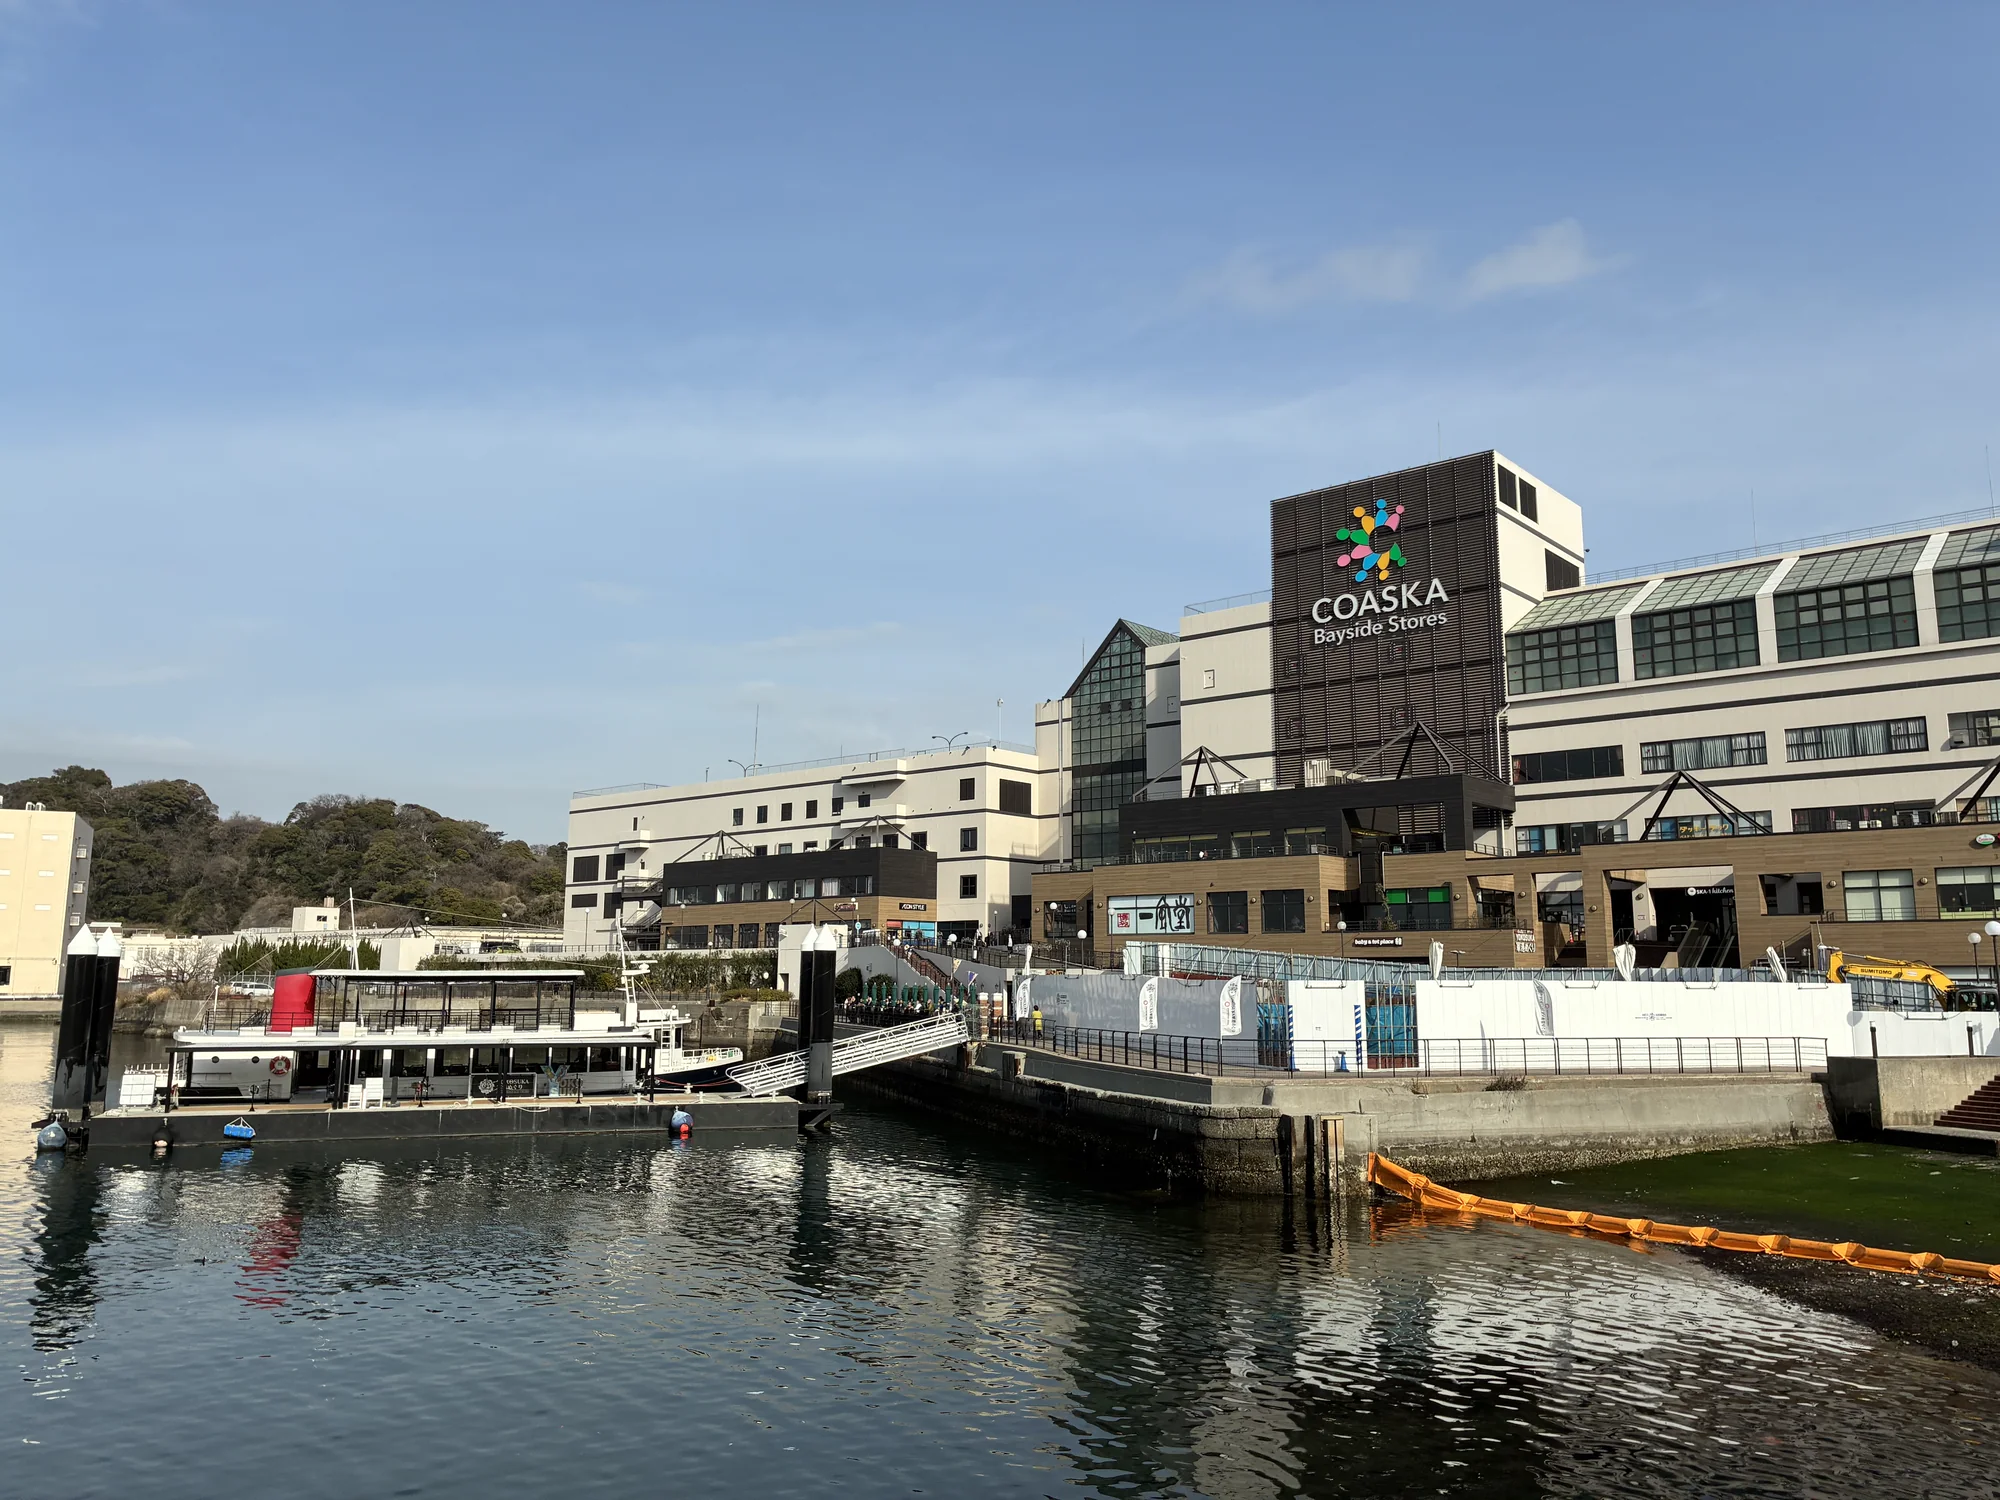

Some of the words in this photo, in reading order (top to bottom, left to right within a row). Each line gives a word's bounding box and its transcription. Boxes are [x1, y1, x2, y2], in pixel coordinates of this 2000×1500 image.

[1312, 578, 1449, 623] COASKA
[1314, 620, 1383, 645] Bayside
[1388, 612, 1448, 632] Stores
[1139, 895, 1190, 931] 一風堂
